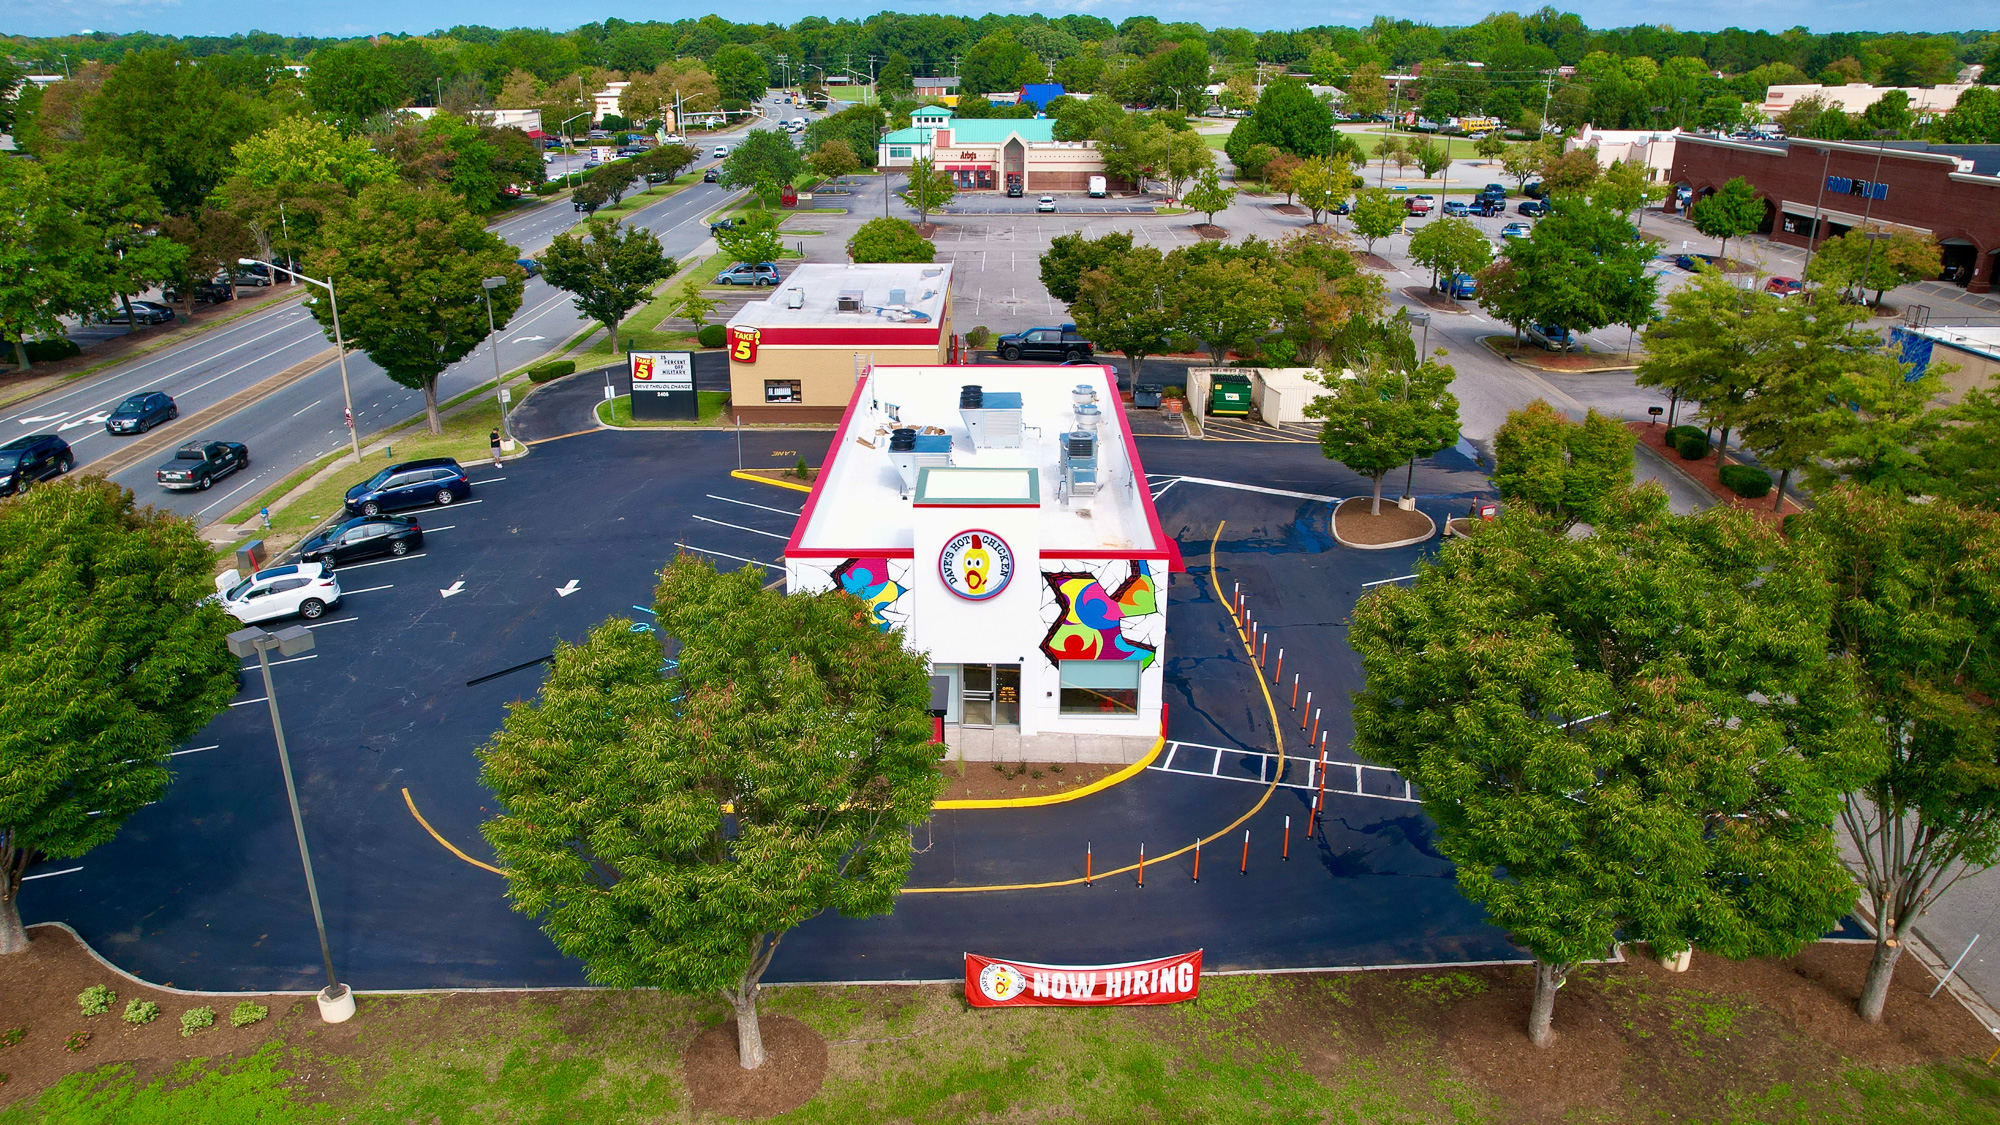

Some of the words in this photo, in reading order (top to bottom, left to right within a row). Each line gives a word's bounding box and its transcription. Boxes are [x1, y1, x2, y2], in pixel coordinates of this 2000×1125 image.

[960, 151, 976, 161] Arby's
[1826, 176, 1853, 194] FOOD
[1863, 181, 1889, 200] LION
[734, 331, 754, 341] TAKE
[734, 341, 752, 360] 5
[636, 365, 650, 378] 5
[950, 535, 971, 552] HOT
[981, 535, 1010, 578] CHICKEN
[943, 551, 958, 585] DAVE'S
[1033, 972, 1097, 999] NOW
[1105, 963, 1194, 998] HIRING
